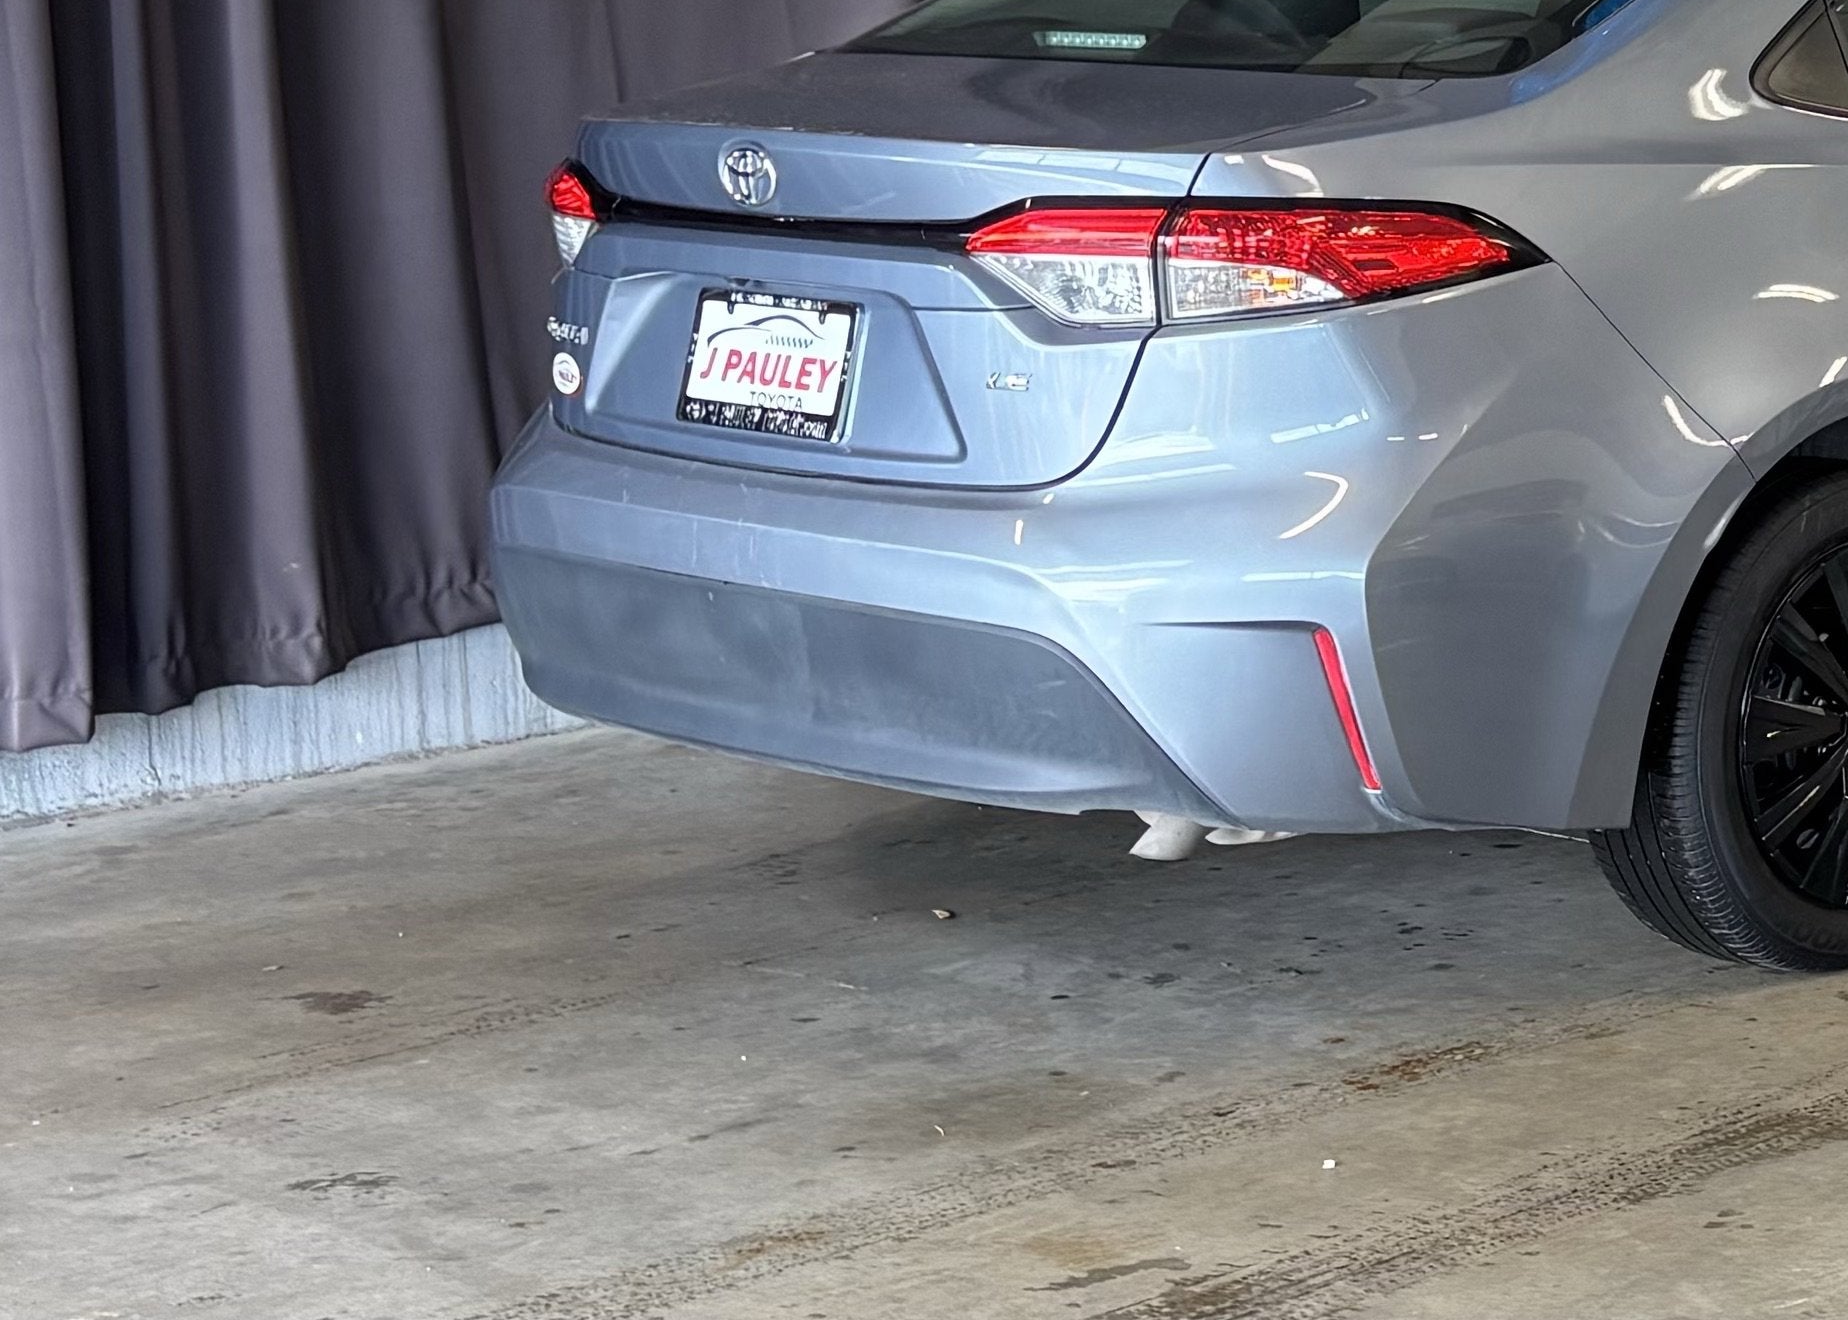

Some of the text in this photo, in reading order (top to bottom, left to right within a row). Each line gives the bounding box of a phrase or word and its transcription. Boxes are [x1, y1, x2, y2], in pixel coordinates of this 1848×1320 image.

[700, 347, 718, 379] J
[721, 349, 838, 393] PAULEY
[749, 391, 803, 410] TOYOTA
